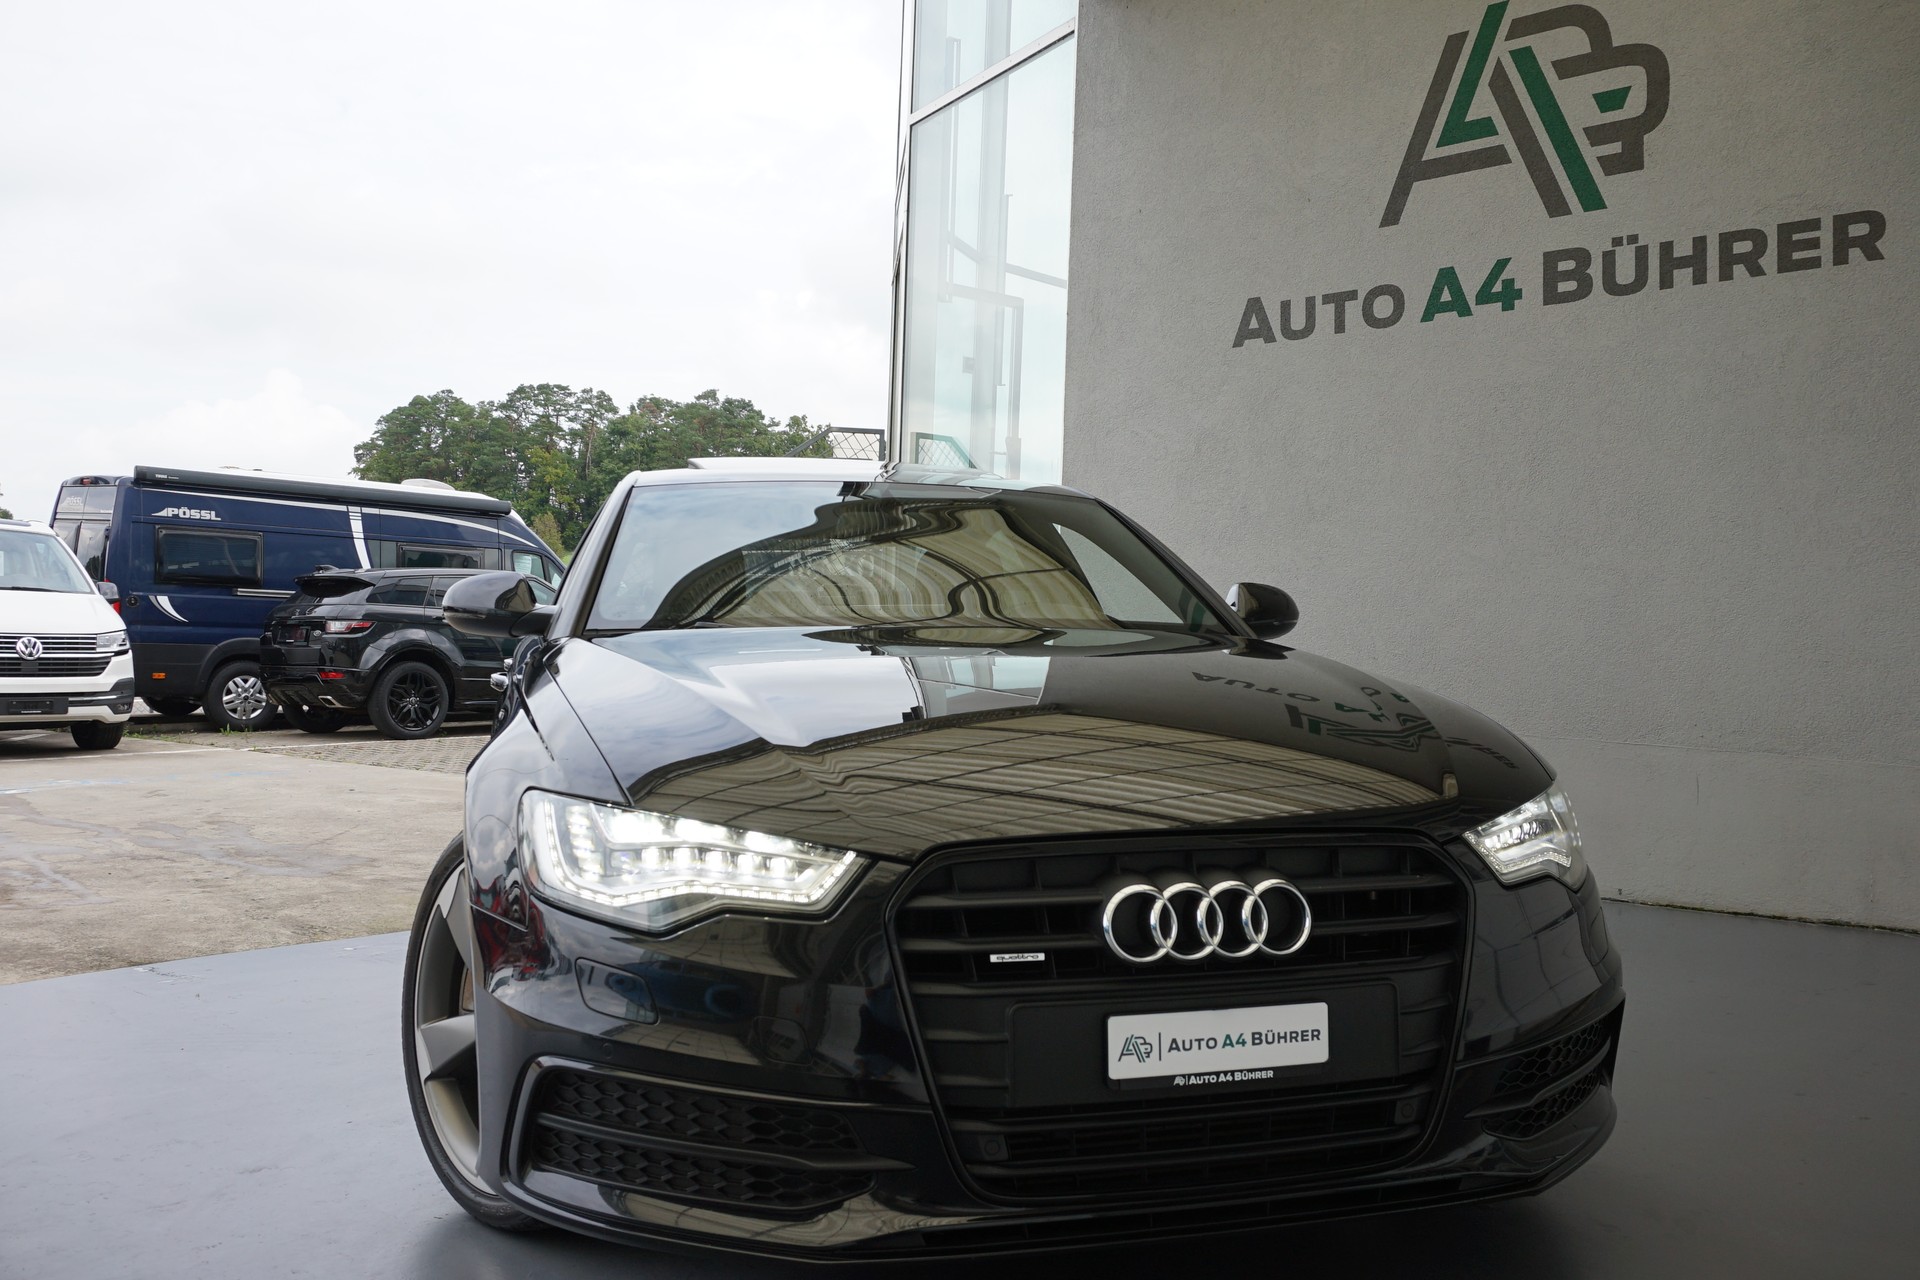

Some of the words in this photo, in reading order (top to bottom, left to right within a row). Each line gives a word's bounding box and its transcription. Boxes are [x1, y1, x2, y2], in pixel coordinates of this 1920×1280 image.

[1231, 282, 1406, 348] AUTO
[1420, 257, 1523, 323] A4
[1542, 209, 1888, 307] BÜHRER
[168, 506, 221, 521] PÖSSL
[996, 953, 1040, 963] quattro
[1168, 1037, 1219, 1054] AUTO
[1222, 1033, 1247, 1050] A4
[1251, 1029, 1322, 1047] BÜHRER
[1189, 1075, 1217, 1085] AUTO
[1218, 1072, 1233, 1083] A4
[1234, 1069, 1275, 1081] BÜHRER
